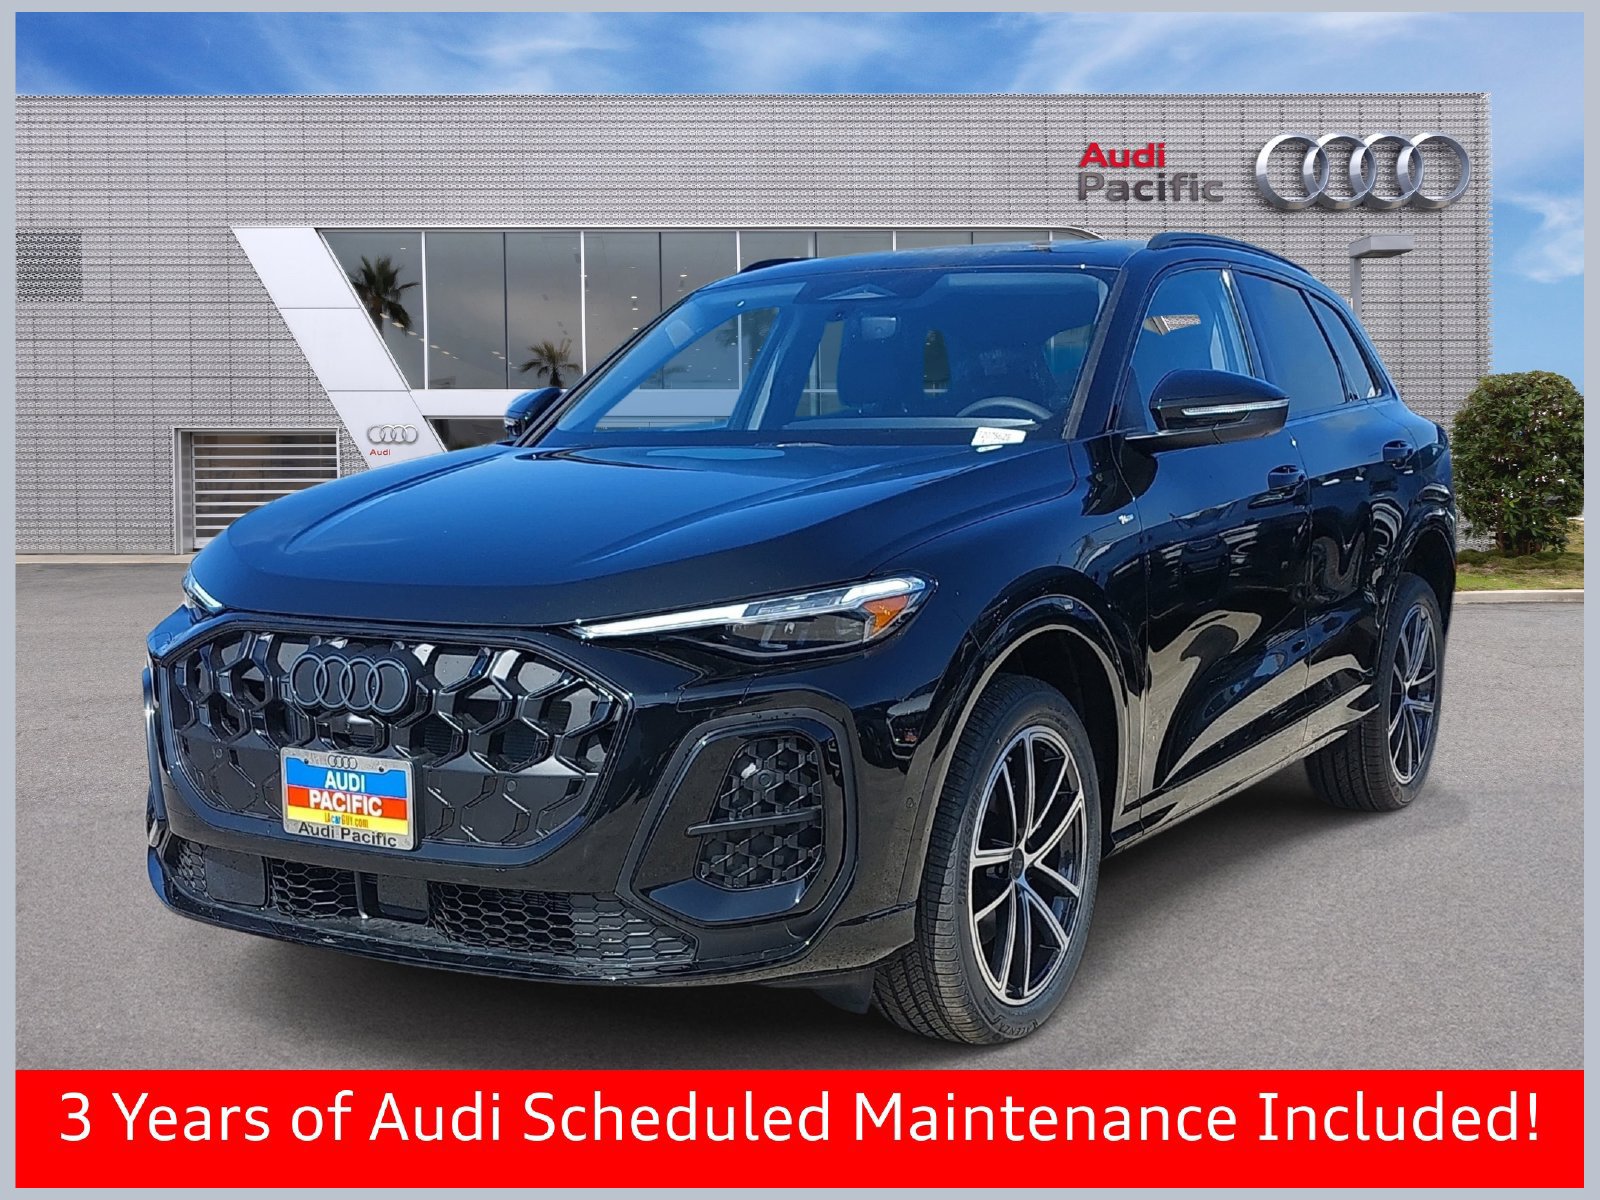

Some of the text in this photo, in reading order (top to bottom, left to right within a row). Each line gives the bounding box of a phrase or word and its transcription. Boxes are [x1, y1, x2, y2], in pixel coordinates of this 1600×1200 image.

[1079, 142, 1166, 168] Audi
[1078, 171, 1224, 202] Pacific
[369, 448, 391, 456] Audi
[324, 770, 366, 793] AUDI
[308, 789, 383, 817] PACIFIC
[298, 821, 397, 848] Audi Pacific
